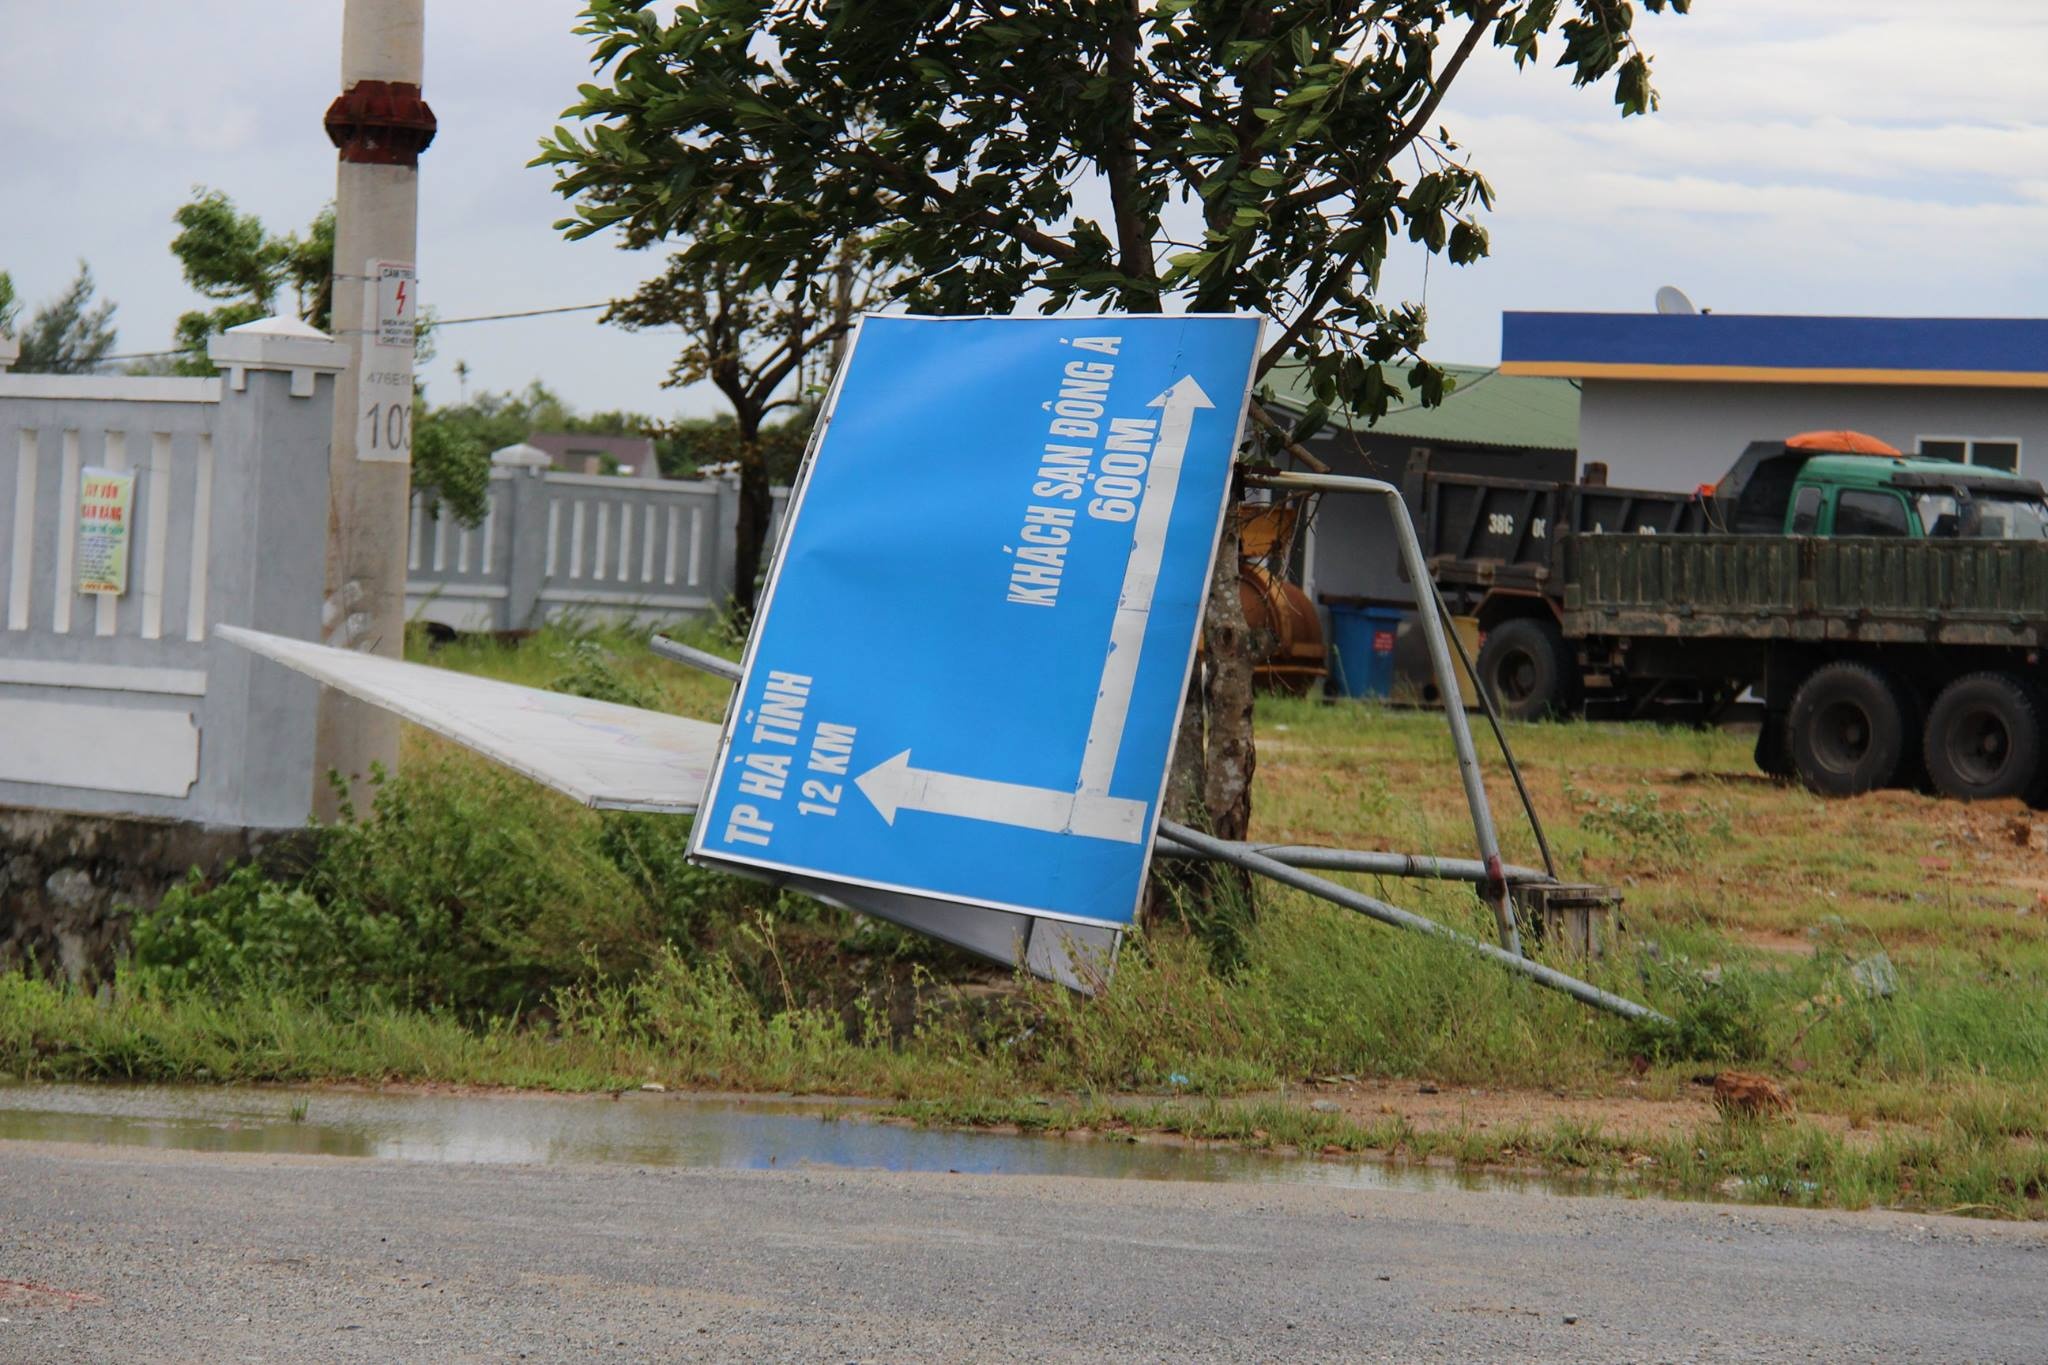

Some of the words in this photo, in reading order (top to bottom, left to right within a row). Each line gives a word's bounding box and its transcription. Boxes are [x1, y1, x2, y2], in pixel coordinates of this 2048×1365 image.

[1059, 336, 1122, 356] Á
[1041, 361, 1115, 439] ĐÔNG
[1032, 443, 1096, 500] SẠN
[1087, 417, 1157, 523] 600M
[1488, 512, 1514, 535] 38C
[1003, 505, 1076, 607] KHÁCH
[745, 670, 813, 746] TĨNH
[807, 722, 857, 775] KM
[734, 753, 792, 800] HÀ
[798, 779, 843, 817] 12
[724, 803, 774, 846] TP
